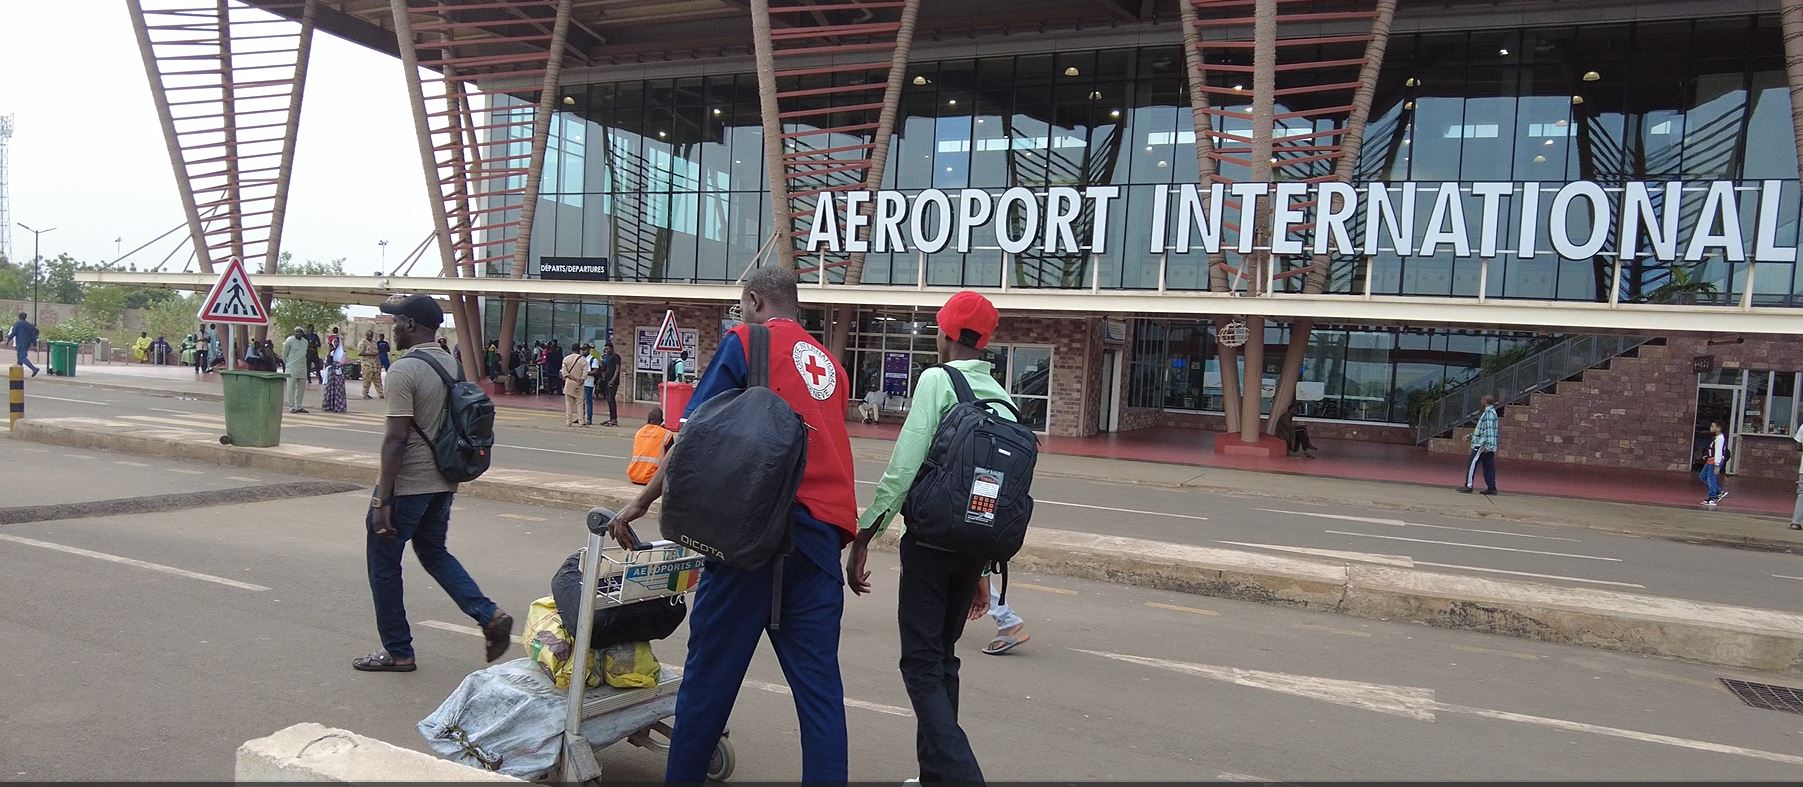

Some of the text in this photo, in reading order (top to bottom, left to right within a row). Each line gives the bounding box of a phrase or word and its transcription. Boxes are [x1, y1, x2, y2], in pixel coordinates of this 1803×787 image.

[806, 179, 1799, 262] AEROPORT INTERNATIONAL
[681, 534, 725, 560] DICOTA
[634, 561, 691, 576] AEOPORTS
